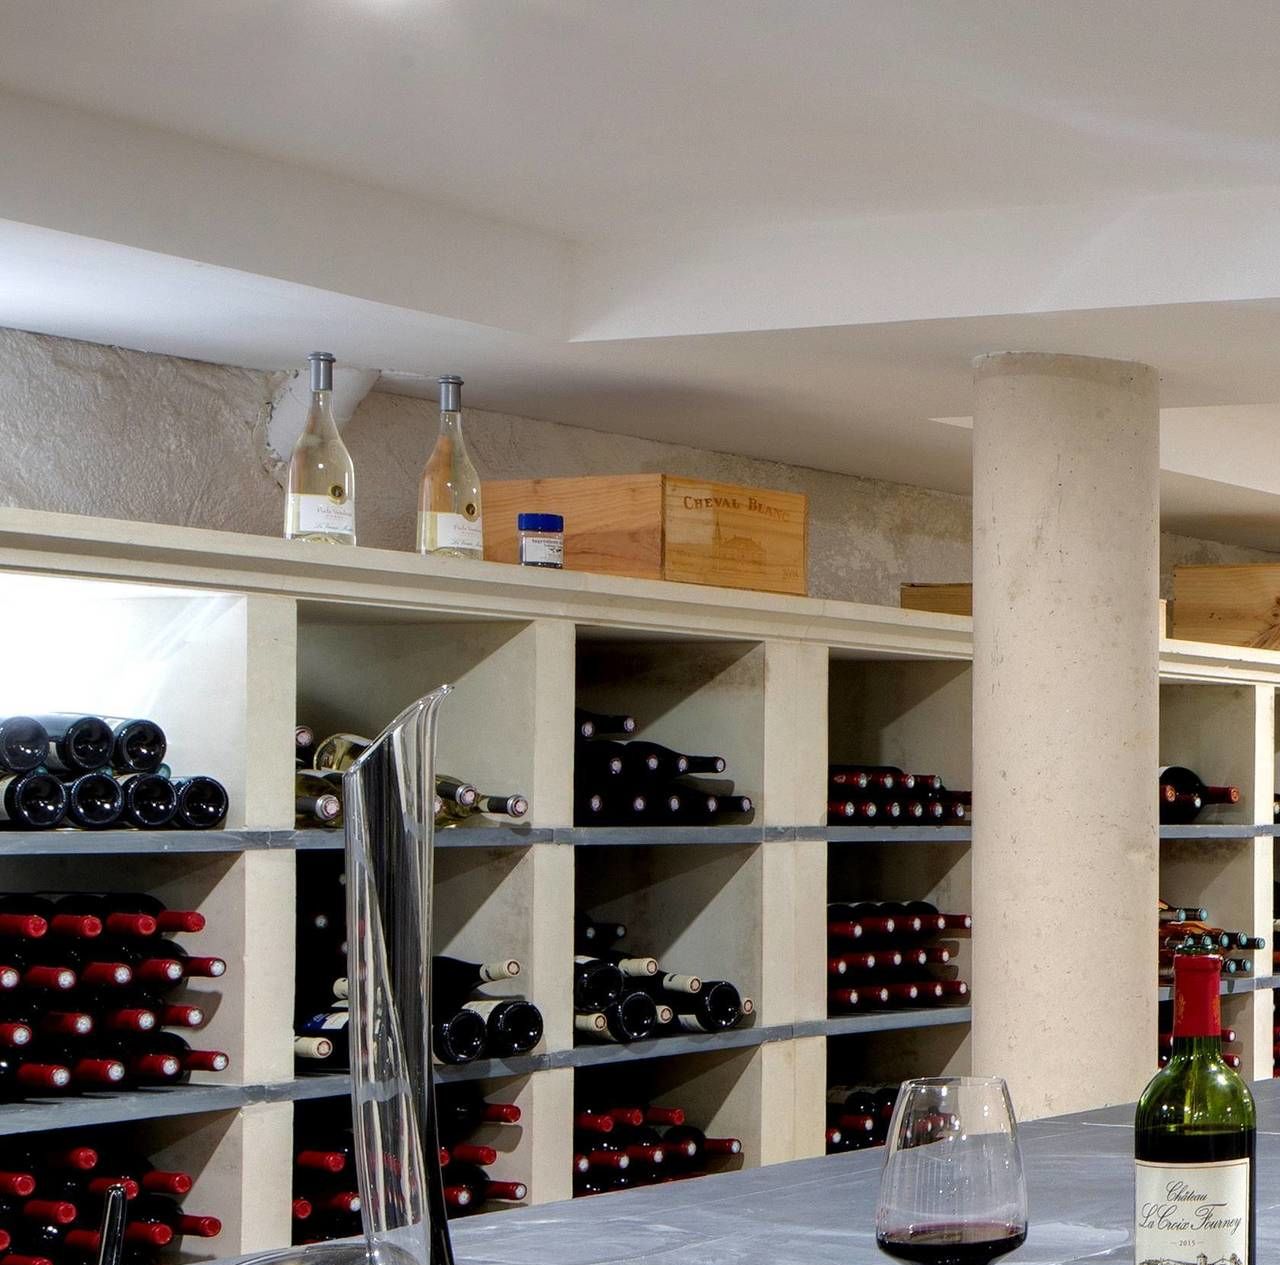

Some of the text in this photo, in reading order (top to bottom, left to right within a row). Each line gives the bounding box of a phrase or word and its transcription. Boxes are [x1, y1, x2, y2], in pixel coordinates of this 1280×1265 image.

[683, 495, 790, 522] CHEVAL BLANC
[1166, 1180, 1209, 1201] Château
[1139, 1203, 1158, 1228] La
[1157, 1204, 1190, 1230] Croix
[1179, 1239, 1196, 1247] 2015
